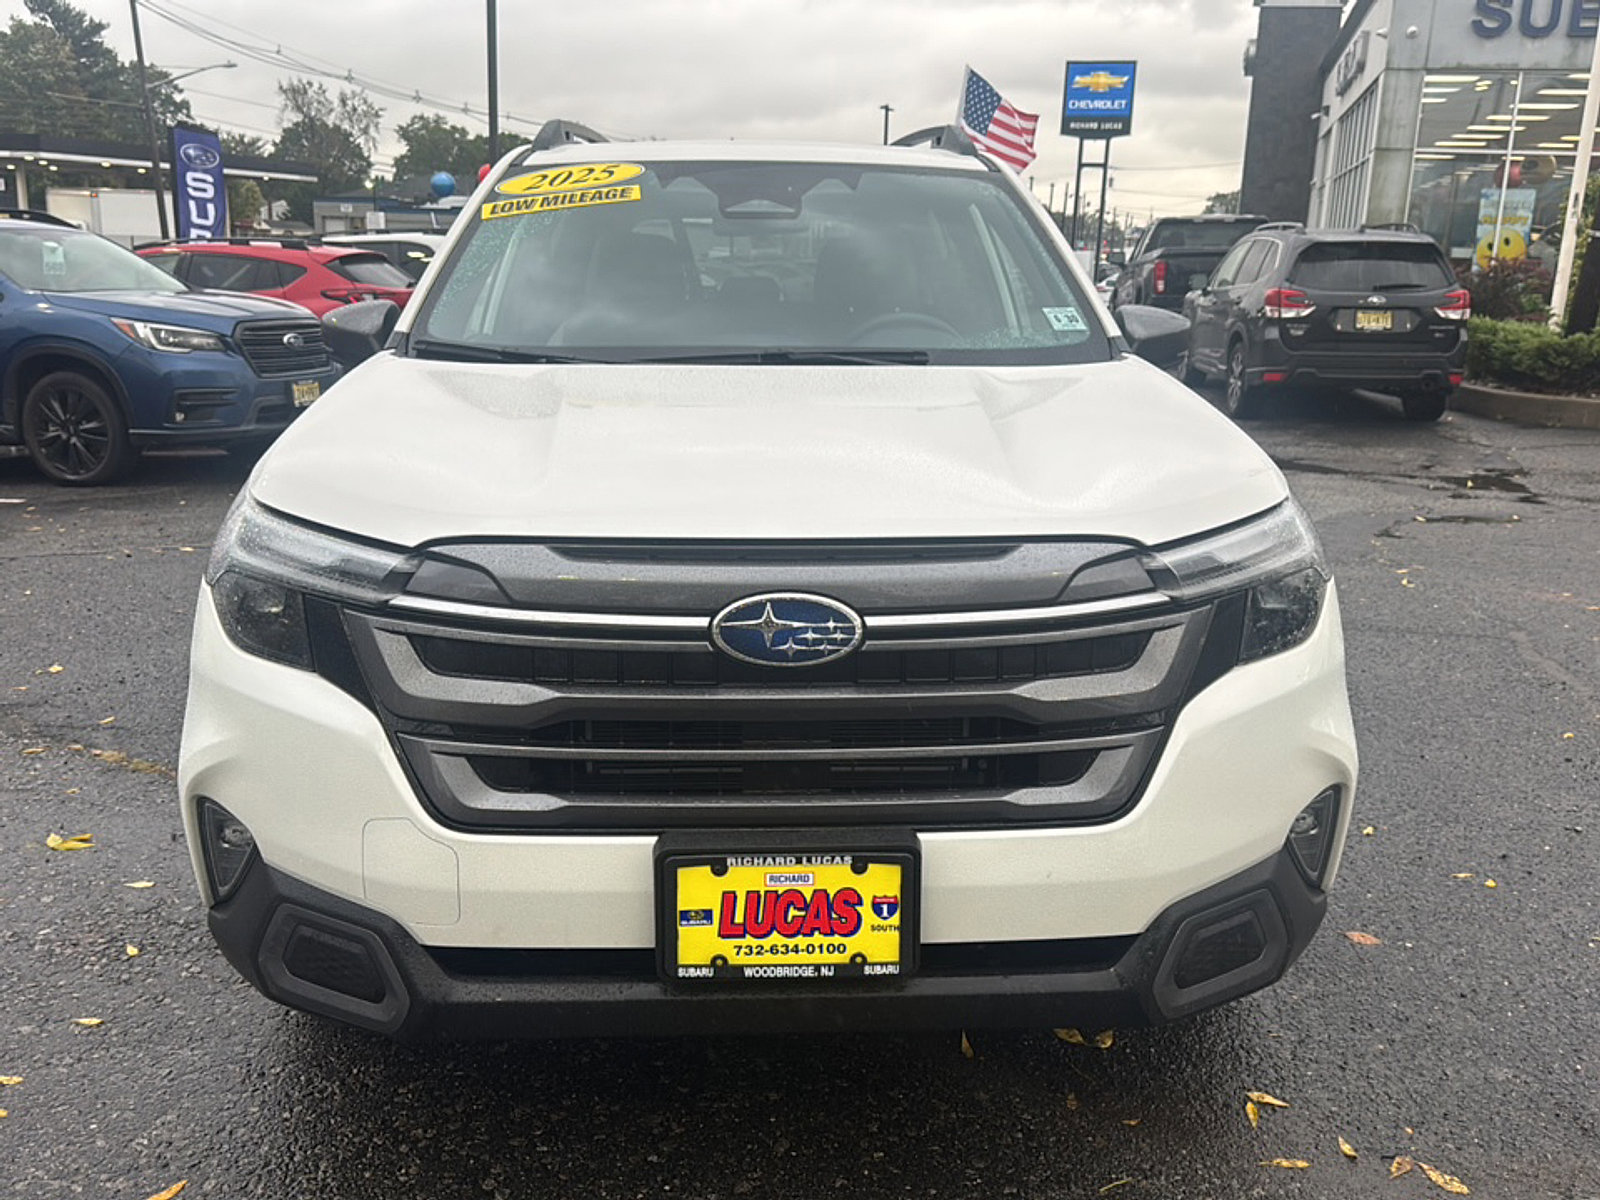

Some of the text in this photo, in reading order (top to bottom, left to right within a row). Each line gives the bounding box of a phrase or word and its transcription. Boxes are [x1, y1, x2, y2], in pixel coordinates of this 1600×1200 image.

[1068, 99, 1127, 111] CHEVROLET
[1069, 121, 1098, 130] RICHARD
[521, 164, 620, 191] 2025
[490, 187, 633, 214] LOW MILEAGE
[726, 856, 853, 867] RICHARD LUCAS
[768, 874, 810, 883] RICHARD
[718, 888, 863, 938] LUCAS
[880, 904, 890, 918] 1
[870, 924, 900, 932] SOUTH
[733, 943, 847, 956] 732-634-0100
[678, 966, 714, 977] SUBARU
[820, 966, 835, 976] NJ
[863, 964, 900, 975] SUBARU
